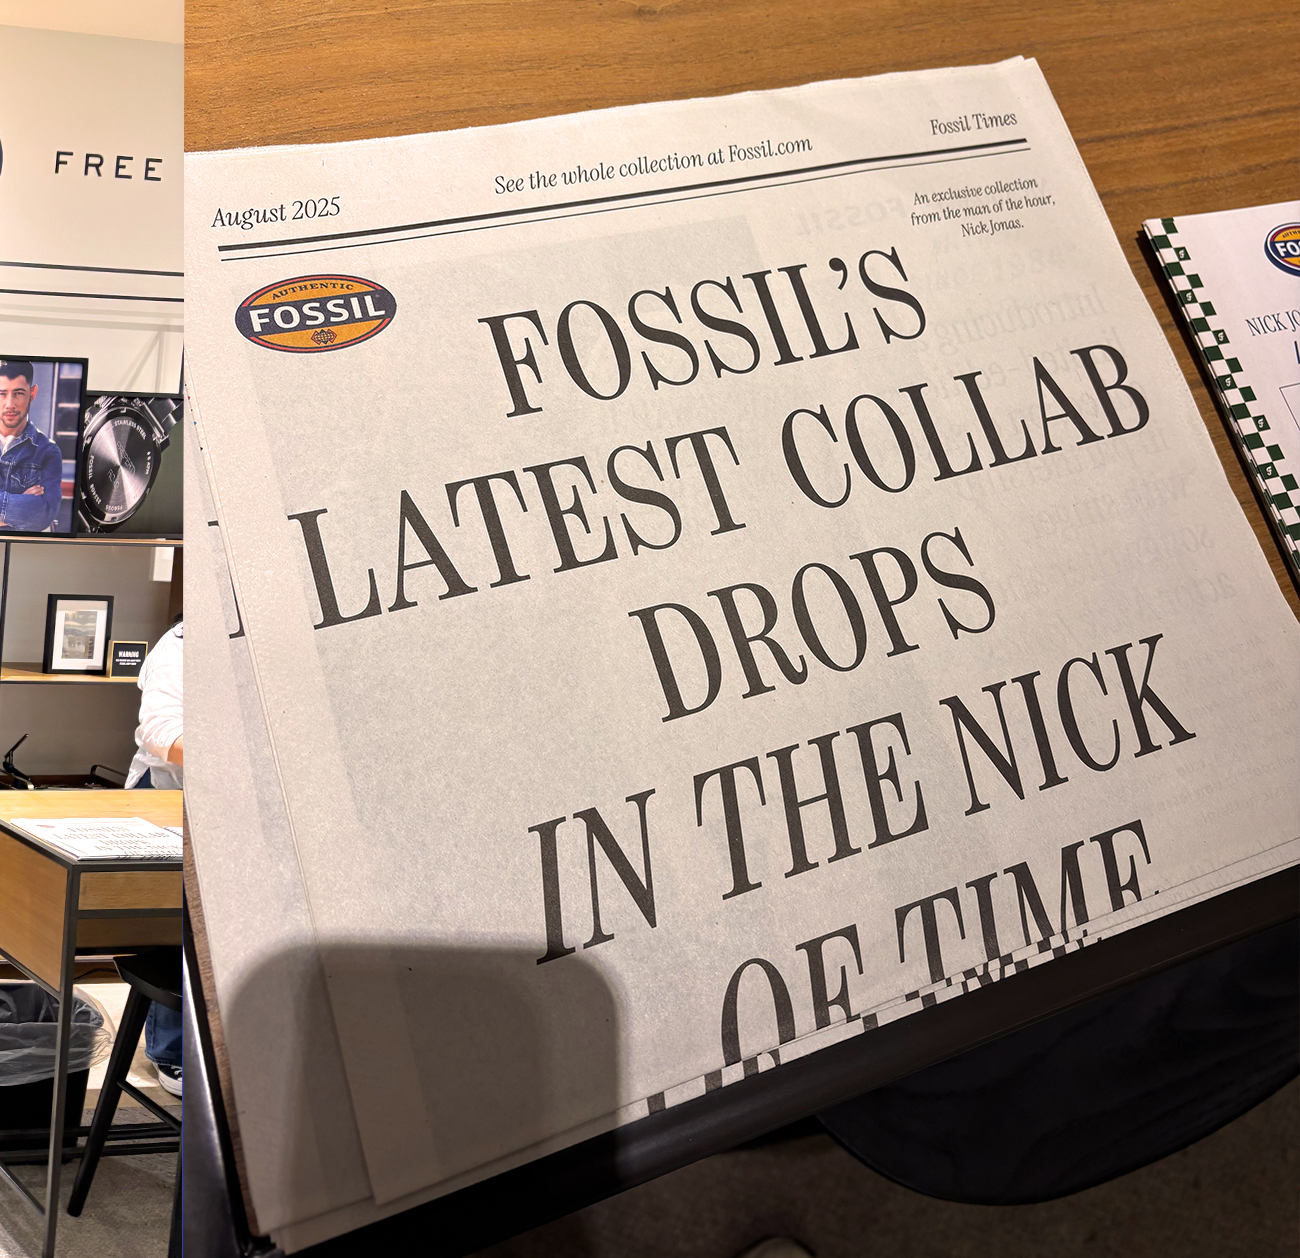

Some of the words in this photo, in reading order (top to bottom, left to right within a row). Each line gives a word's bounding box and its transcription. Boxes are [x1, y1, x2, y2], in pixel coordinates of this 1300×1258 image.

[930, 115, 971, 135] Fossil
[972, 113, 1018, 130] Times
[55, 151, 163, 182] FREE
[494, 175, 524, 195] See
[529, 171, 557, 190] the
[561, 162, 615, 186] whole
[619, 153, 704, 178] collection
[708, 148, 725, 166] at
[728, 138, 813, 163] Fossil.com
[913, 192, 931, 206] An
[931, 186, 983, 203] exclusive
[984, 178, 1038, 196] collection
[211, 204, 287, 230] August
[292, 196, 341, 220] 2025
[910, 212, 941, 226] from
[943, 207, 962, 220] the
[962, 205, 991, 217] man
[992, 200, 1004, 213] of
[1005, 198, 1023, 211] the
[1025, 195, 1056, 208] hour,
[961, 221, 989, 238] Nick
[989, 219, 1024, 235] Jonas.
[1275, 241, 1300, 256] FO
[272, 282, 354, 300] AUTHENTIC
[249, 295, 386, 333] FOSSIL
[1245, 313, 1288, 337] NICK
[1285, 309, 1300, 332] JO
[287, 427, 745, 630] LATEST
[781, 345, 1150, 508] COLLAB
[628, 527, 996, 723] DROPS
[528, 789, 658, 965] IN
[692, 713, 929, 900] THE
[939, 633, 1196, 816] NICK
[721, 924, 865, 1067] OF
